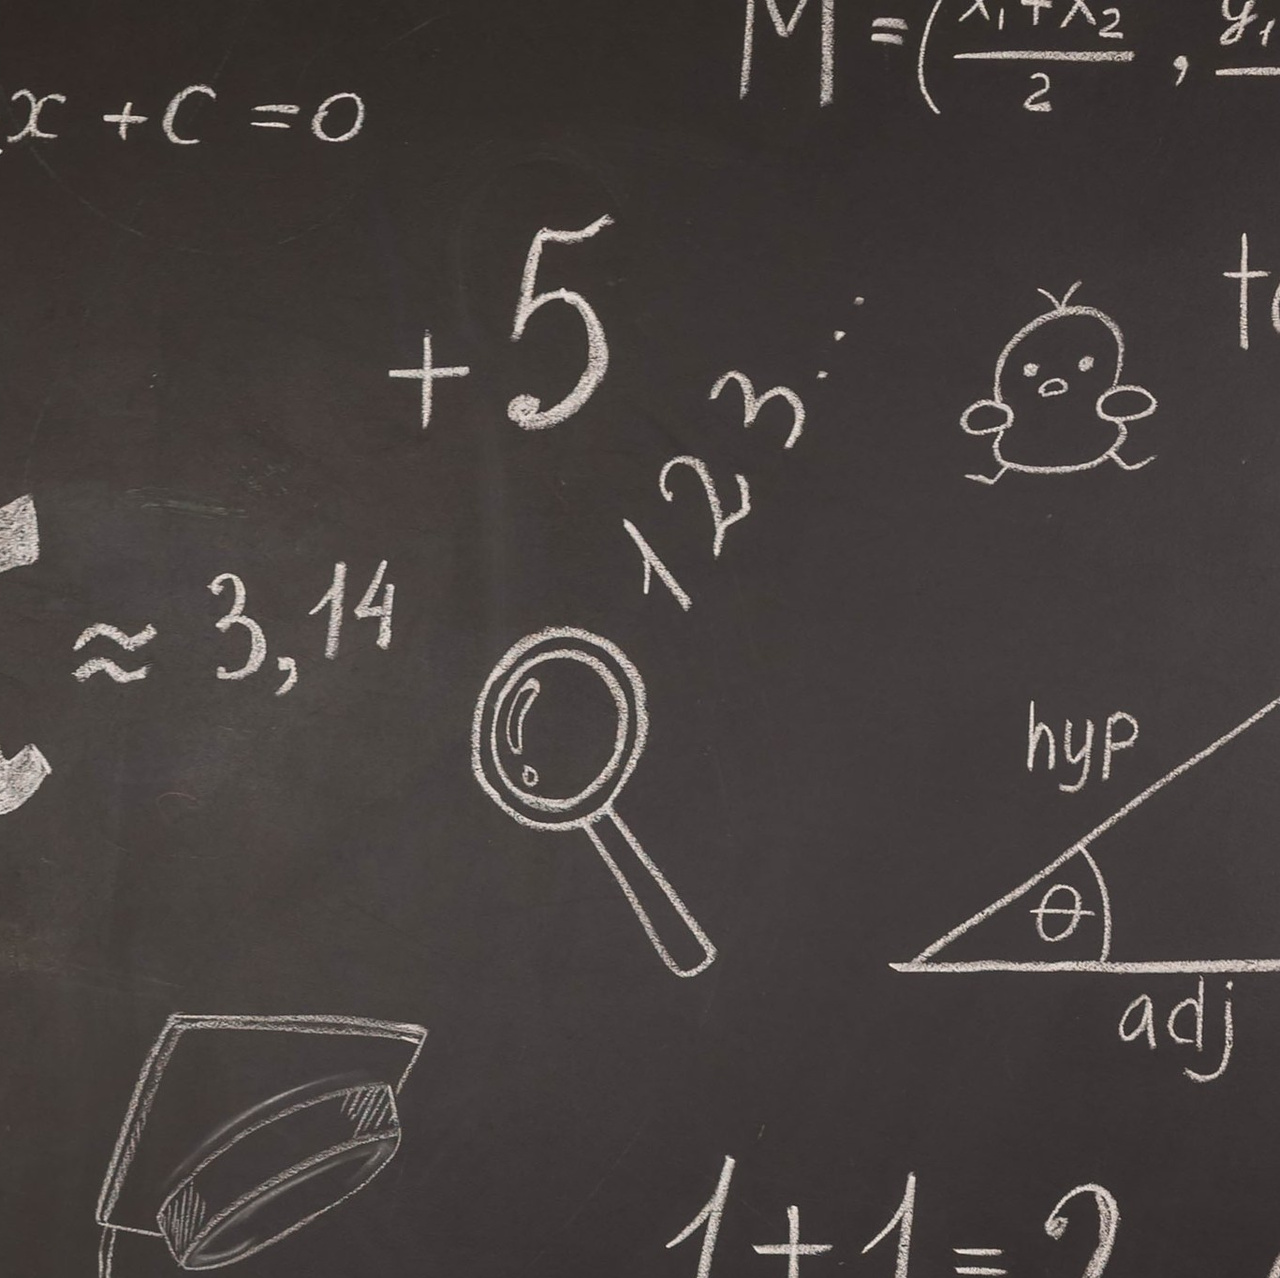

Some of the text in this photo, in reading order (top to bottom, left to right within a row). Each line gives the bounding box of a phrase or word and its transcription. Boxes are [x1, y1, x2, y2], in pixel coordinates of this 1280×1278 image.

[1022, 72, 1053, 113] 2
[1026, 700, 1140, 793] hyp
[1121, 975, 1234, 1083] adj
